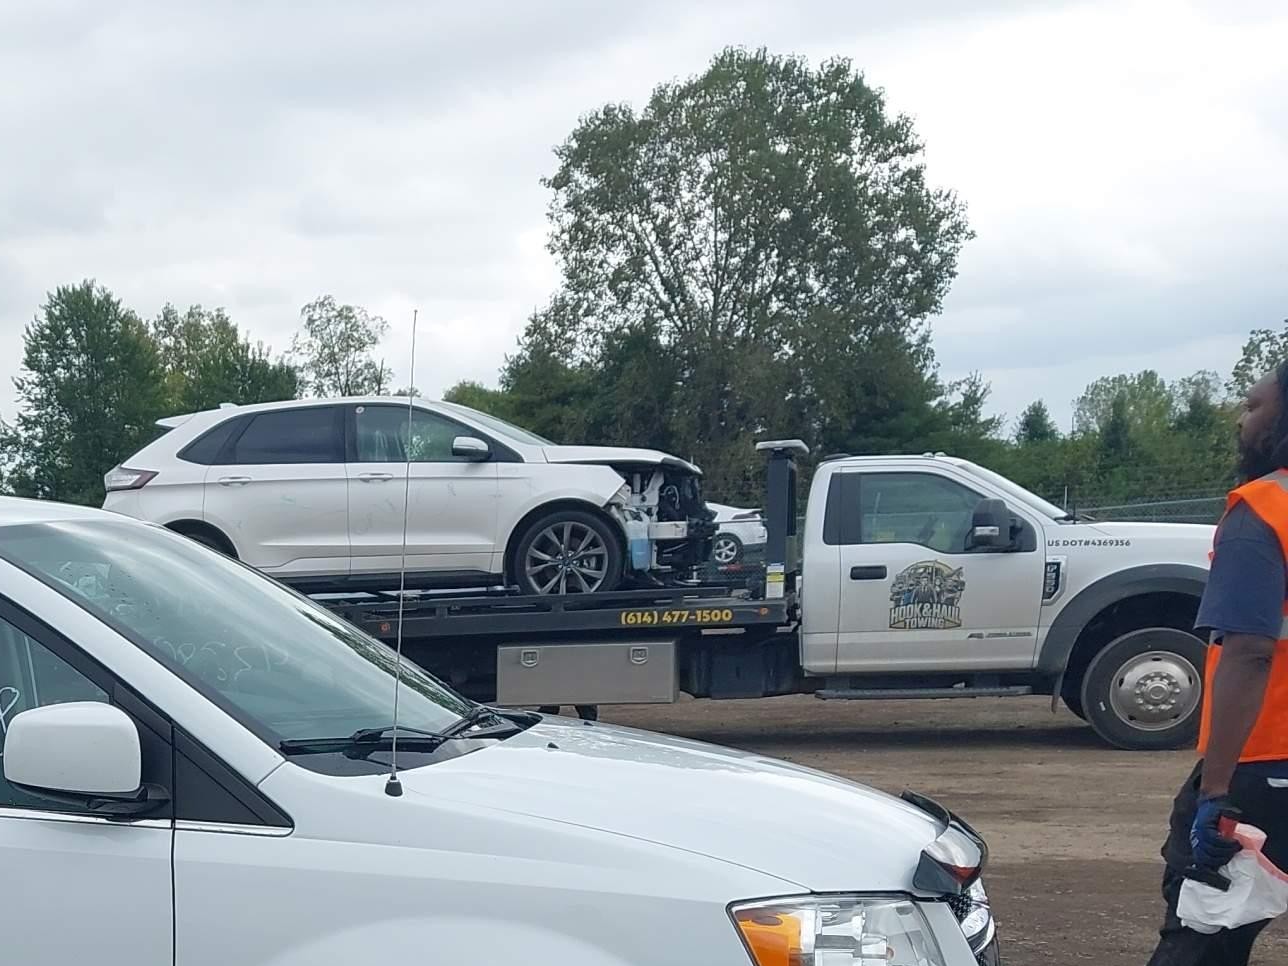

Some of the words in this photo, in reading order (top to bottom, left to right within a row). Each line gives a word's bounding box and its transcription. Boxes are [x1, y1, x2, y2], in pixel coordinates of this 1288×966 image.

[621, 611, 658, 625] (614)
[662, 609, 732, 623] 477-1500
[905, 617, 945, 629] TOWING
